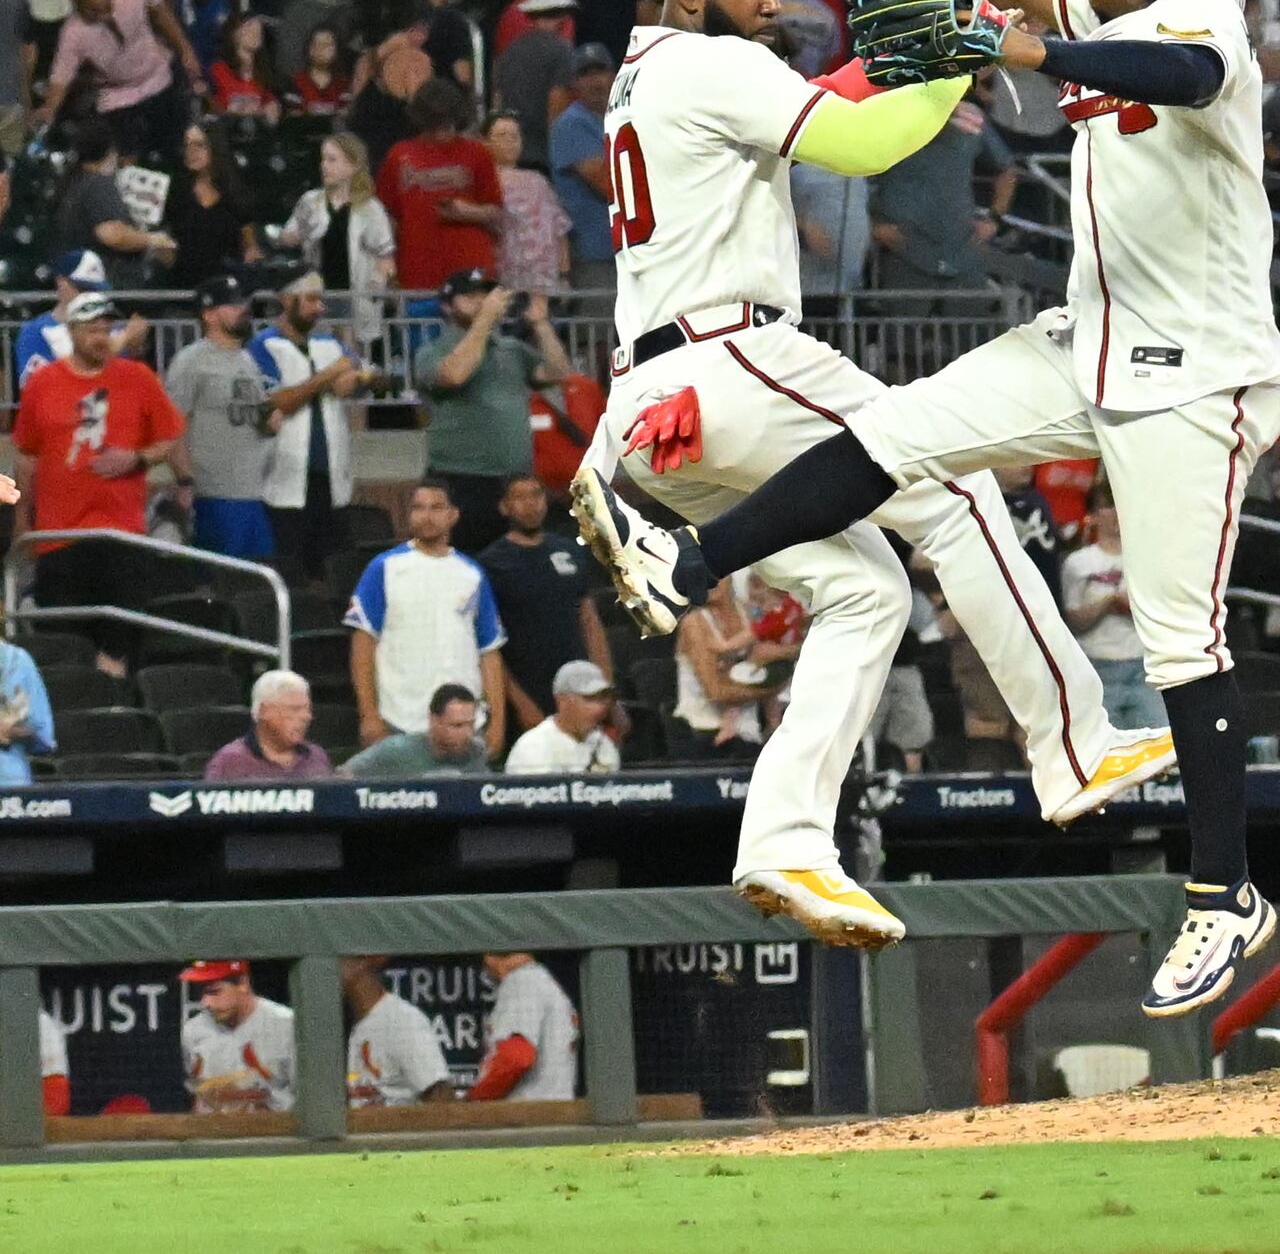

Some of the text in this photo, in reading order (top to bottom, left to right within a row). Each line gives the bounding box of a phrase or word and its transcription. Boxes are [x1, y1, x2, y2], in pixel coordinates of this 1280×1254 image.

[196, 788, 315, 814] YANMAR
[355, 787, 438, 809] Tractors
[480, 780, 674, 808] Compact Equipment
[937, 786, 1015, 808] Tractors
